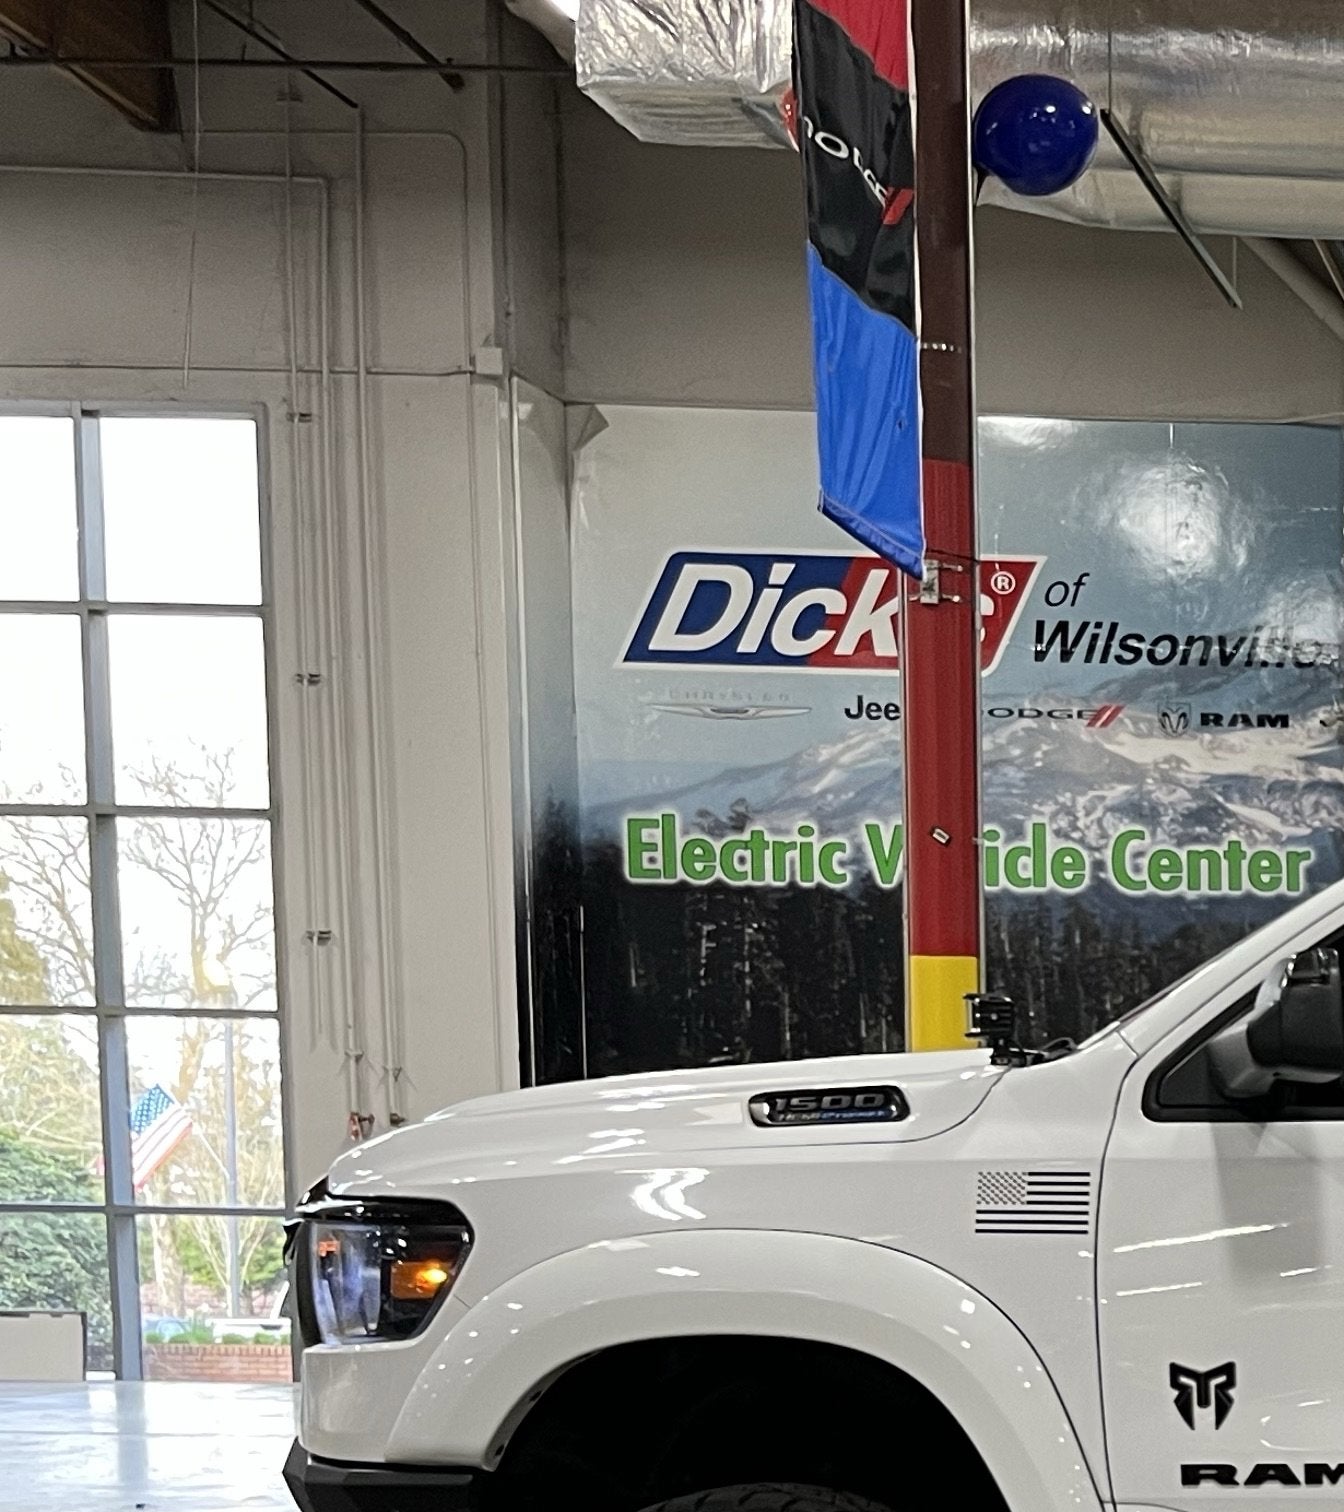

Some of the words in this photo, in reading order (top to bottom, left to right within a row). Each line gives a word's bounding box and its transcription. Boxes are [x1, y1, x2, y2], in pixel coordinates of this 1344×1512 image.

[648, 563, 995, 657] Dick
[1044, 573, 1090, 607] of
[1033, 619, 1319, 669] Wilsonvi
[844, 695, 901, 721] Jee
[983, 707, 1098, 720] ODGE
[1200, 712, 1290, 729] RAM
[627, 813, 848, 884] Electric
[865, 822, 1087, 889] Vicle
[1111, 829, 1312, 892] Center
[775, 1093, 885, 1112] 1500
